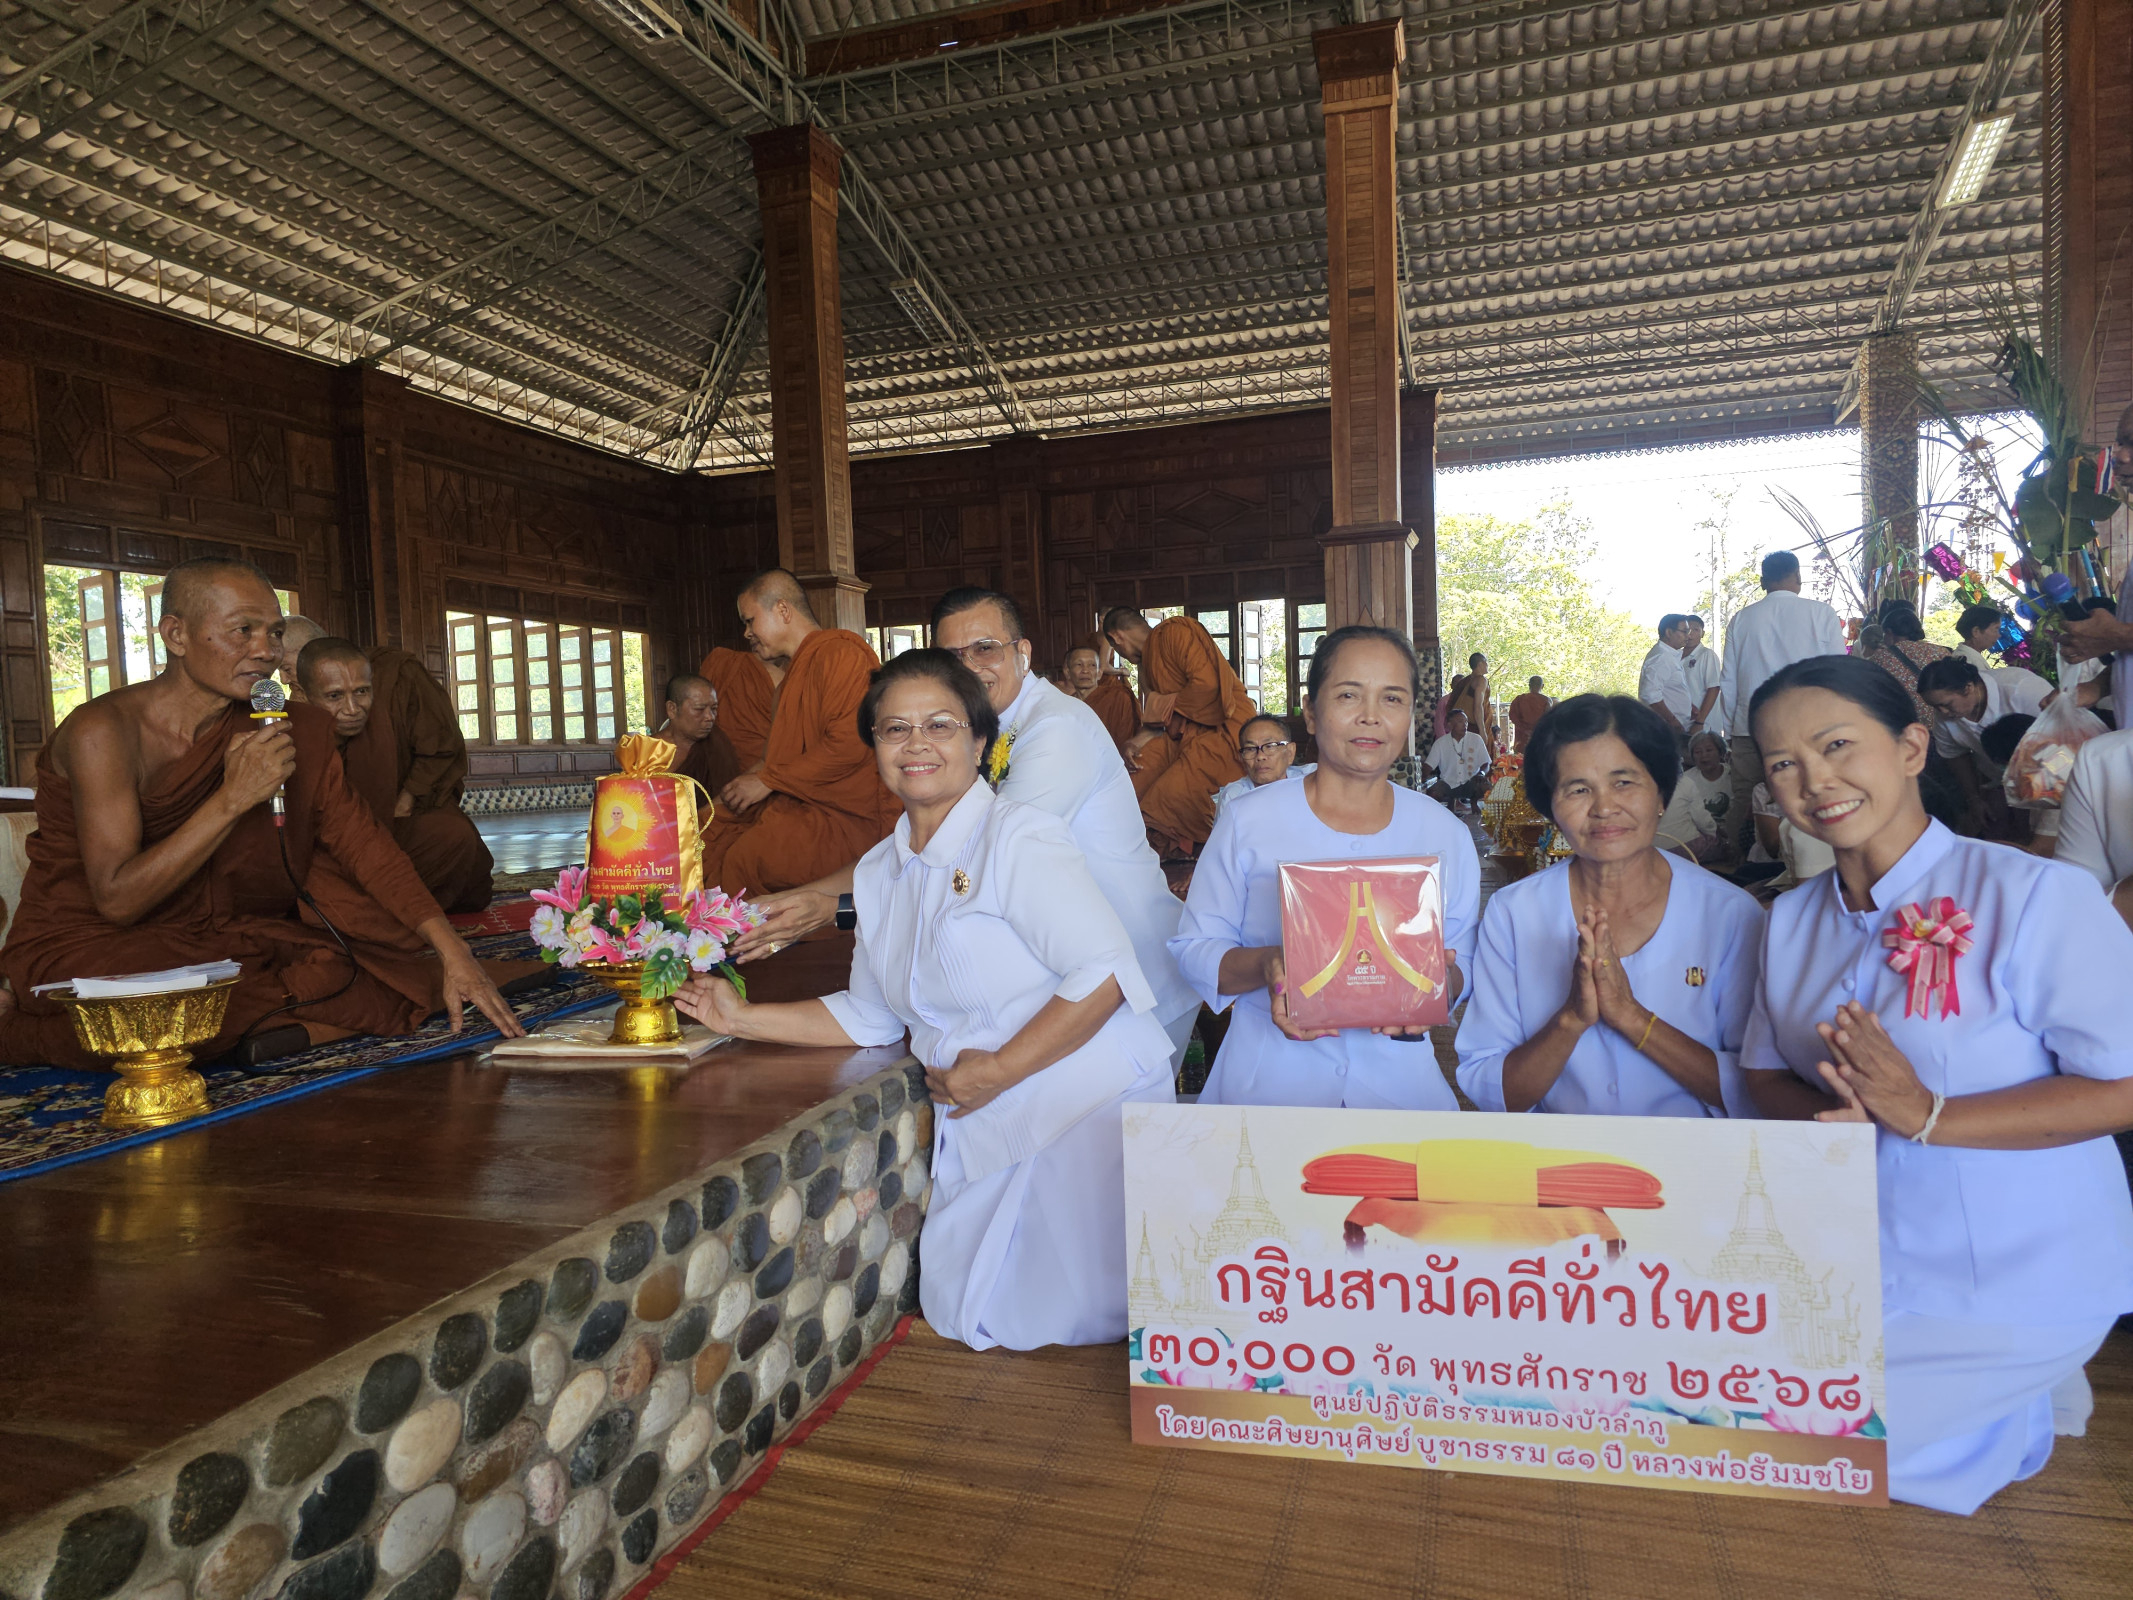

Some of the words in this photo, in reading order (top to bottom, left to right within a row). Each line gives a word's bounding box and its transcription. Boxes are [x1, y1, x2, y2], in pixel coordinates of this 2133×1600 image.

[1216, 1243, 1767, 1335] กฐินสามัคคีทั่วไทย
[1149, 1334, 1356, 1377] ๓๐,๐๐๐
[1372, 1343, 1416, 1378] วัด
[1430, 1352, 1648, 1397] พุทธศักราช
[1666, 1360, 1863, 1412] ๒๕๖๘
[1313, 1389, 1667, 1445] ศูนย์ปฏิบัติธรรมหนองบัวลำภู
[1416, 1436, 1546, 1465] บูชาธรรม
[1556, 1448, 1596, 1469] ๘๑
[1603, 1443, 1622, 1470] ปี
[1632, 1453, 1868, 1491] หลวงพ่อธัมมชโย
